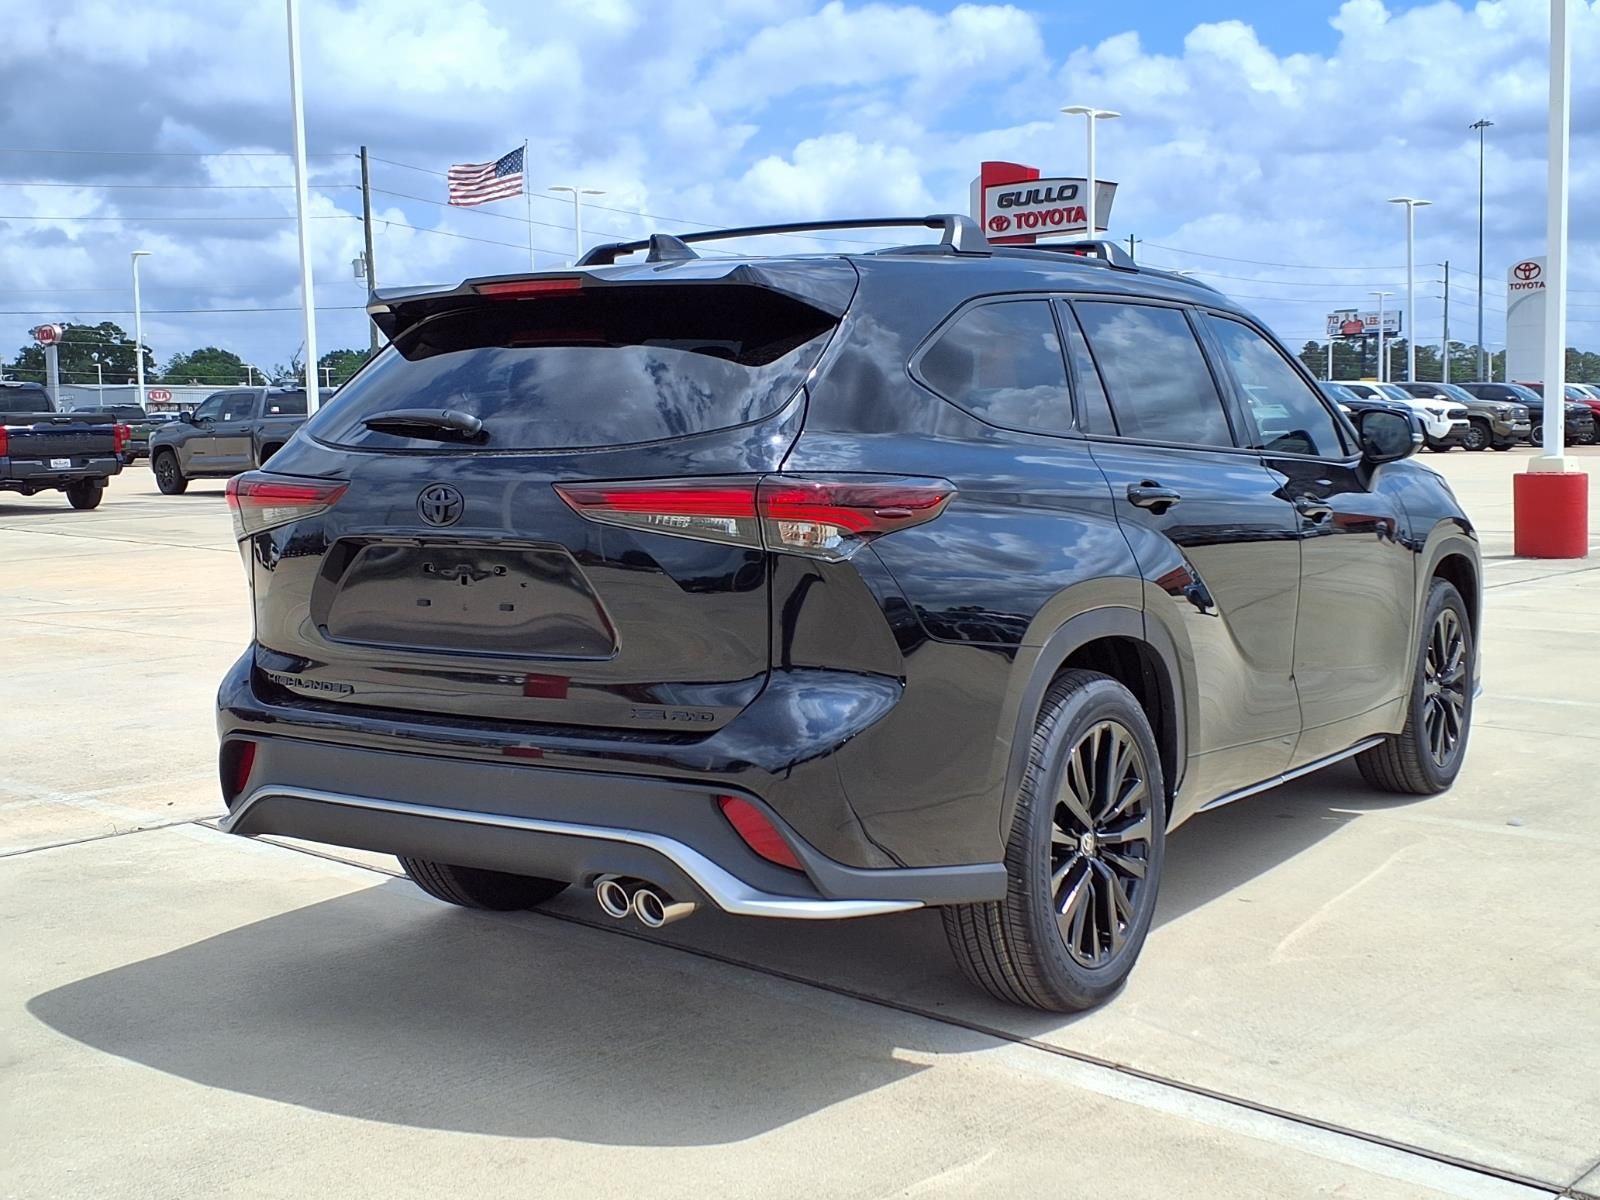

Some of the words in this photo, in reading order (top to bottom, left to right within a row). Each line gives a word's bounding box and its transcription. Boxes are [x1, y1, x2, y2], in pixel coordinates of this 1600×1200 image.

[997, 184, 1079, 208] GULLO
[1013, 206, 1087, 229] TOYOTA
[1509, 281, 1546, 290] TOYOTA
[151, 391, 167, 399] KIA
[267, 673, 355, 695] HIGHLANDER
